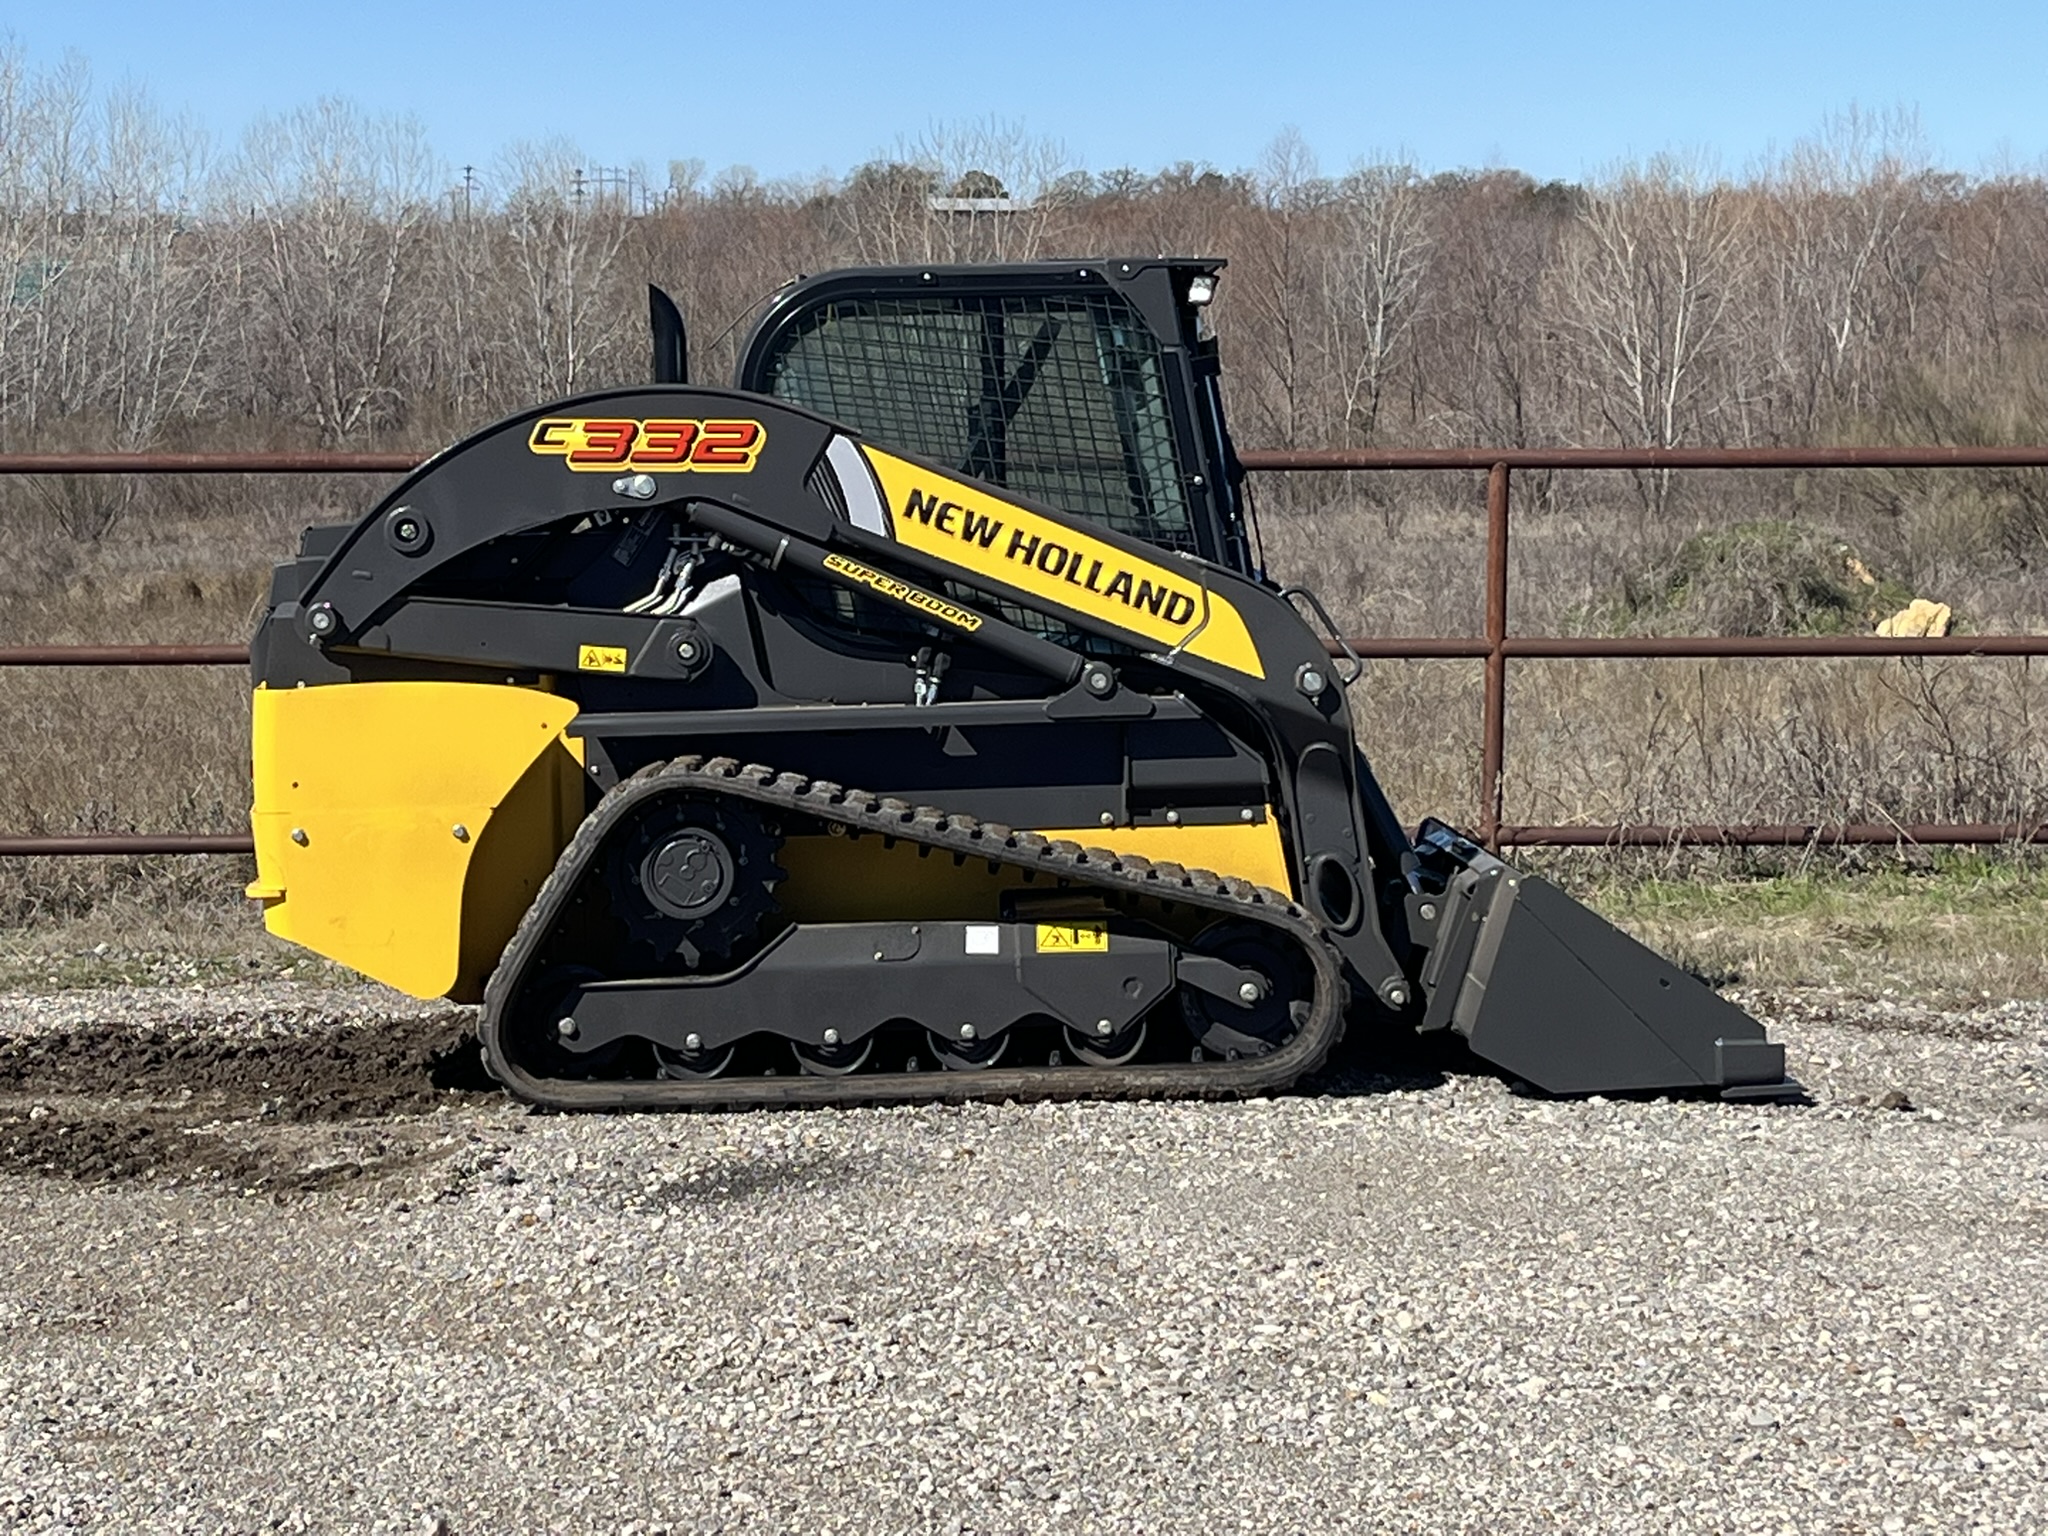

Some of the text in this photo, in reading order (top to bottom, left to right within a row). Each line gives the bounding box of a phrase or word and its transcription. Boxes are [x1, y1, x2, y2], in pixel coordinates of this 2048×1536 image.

[532, 420, 762, 467] C332
[903, 488, 1196, 626] NEW HOLLAND
